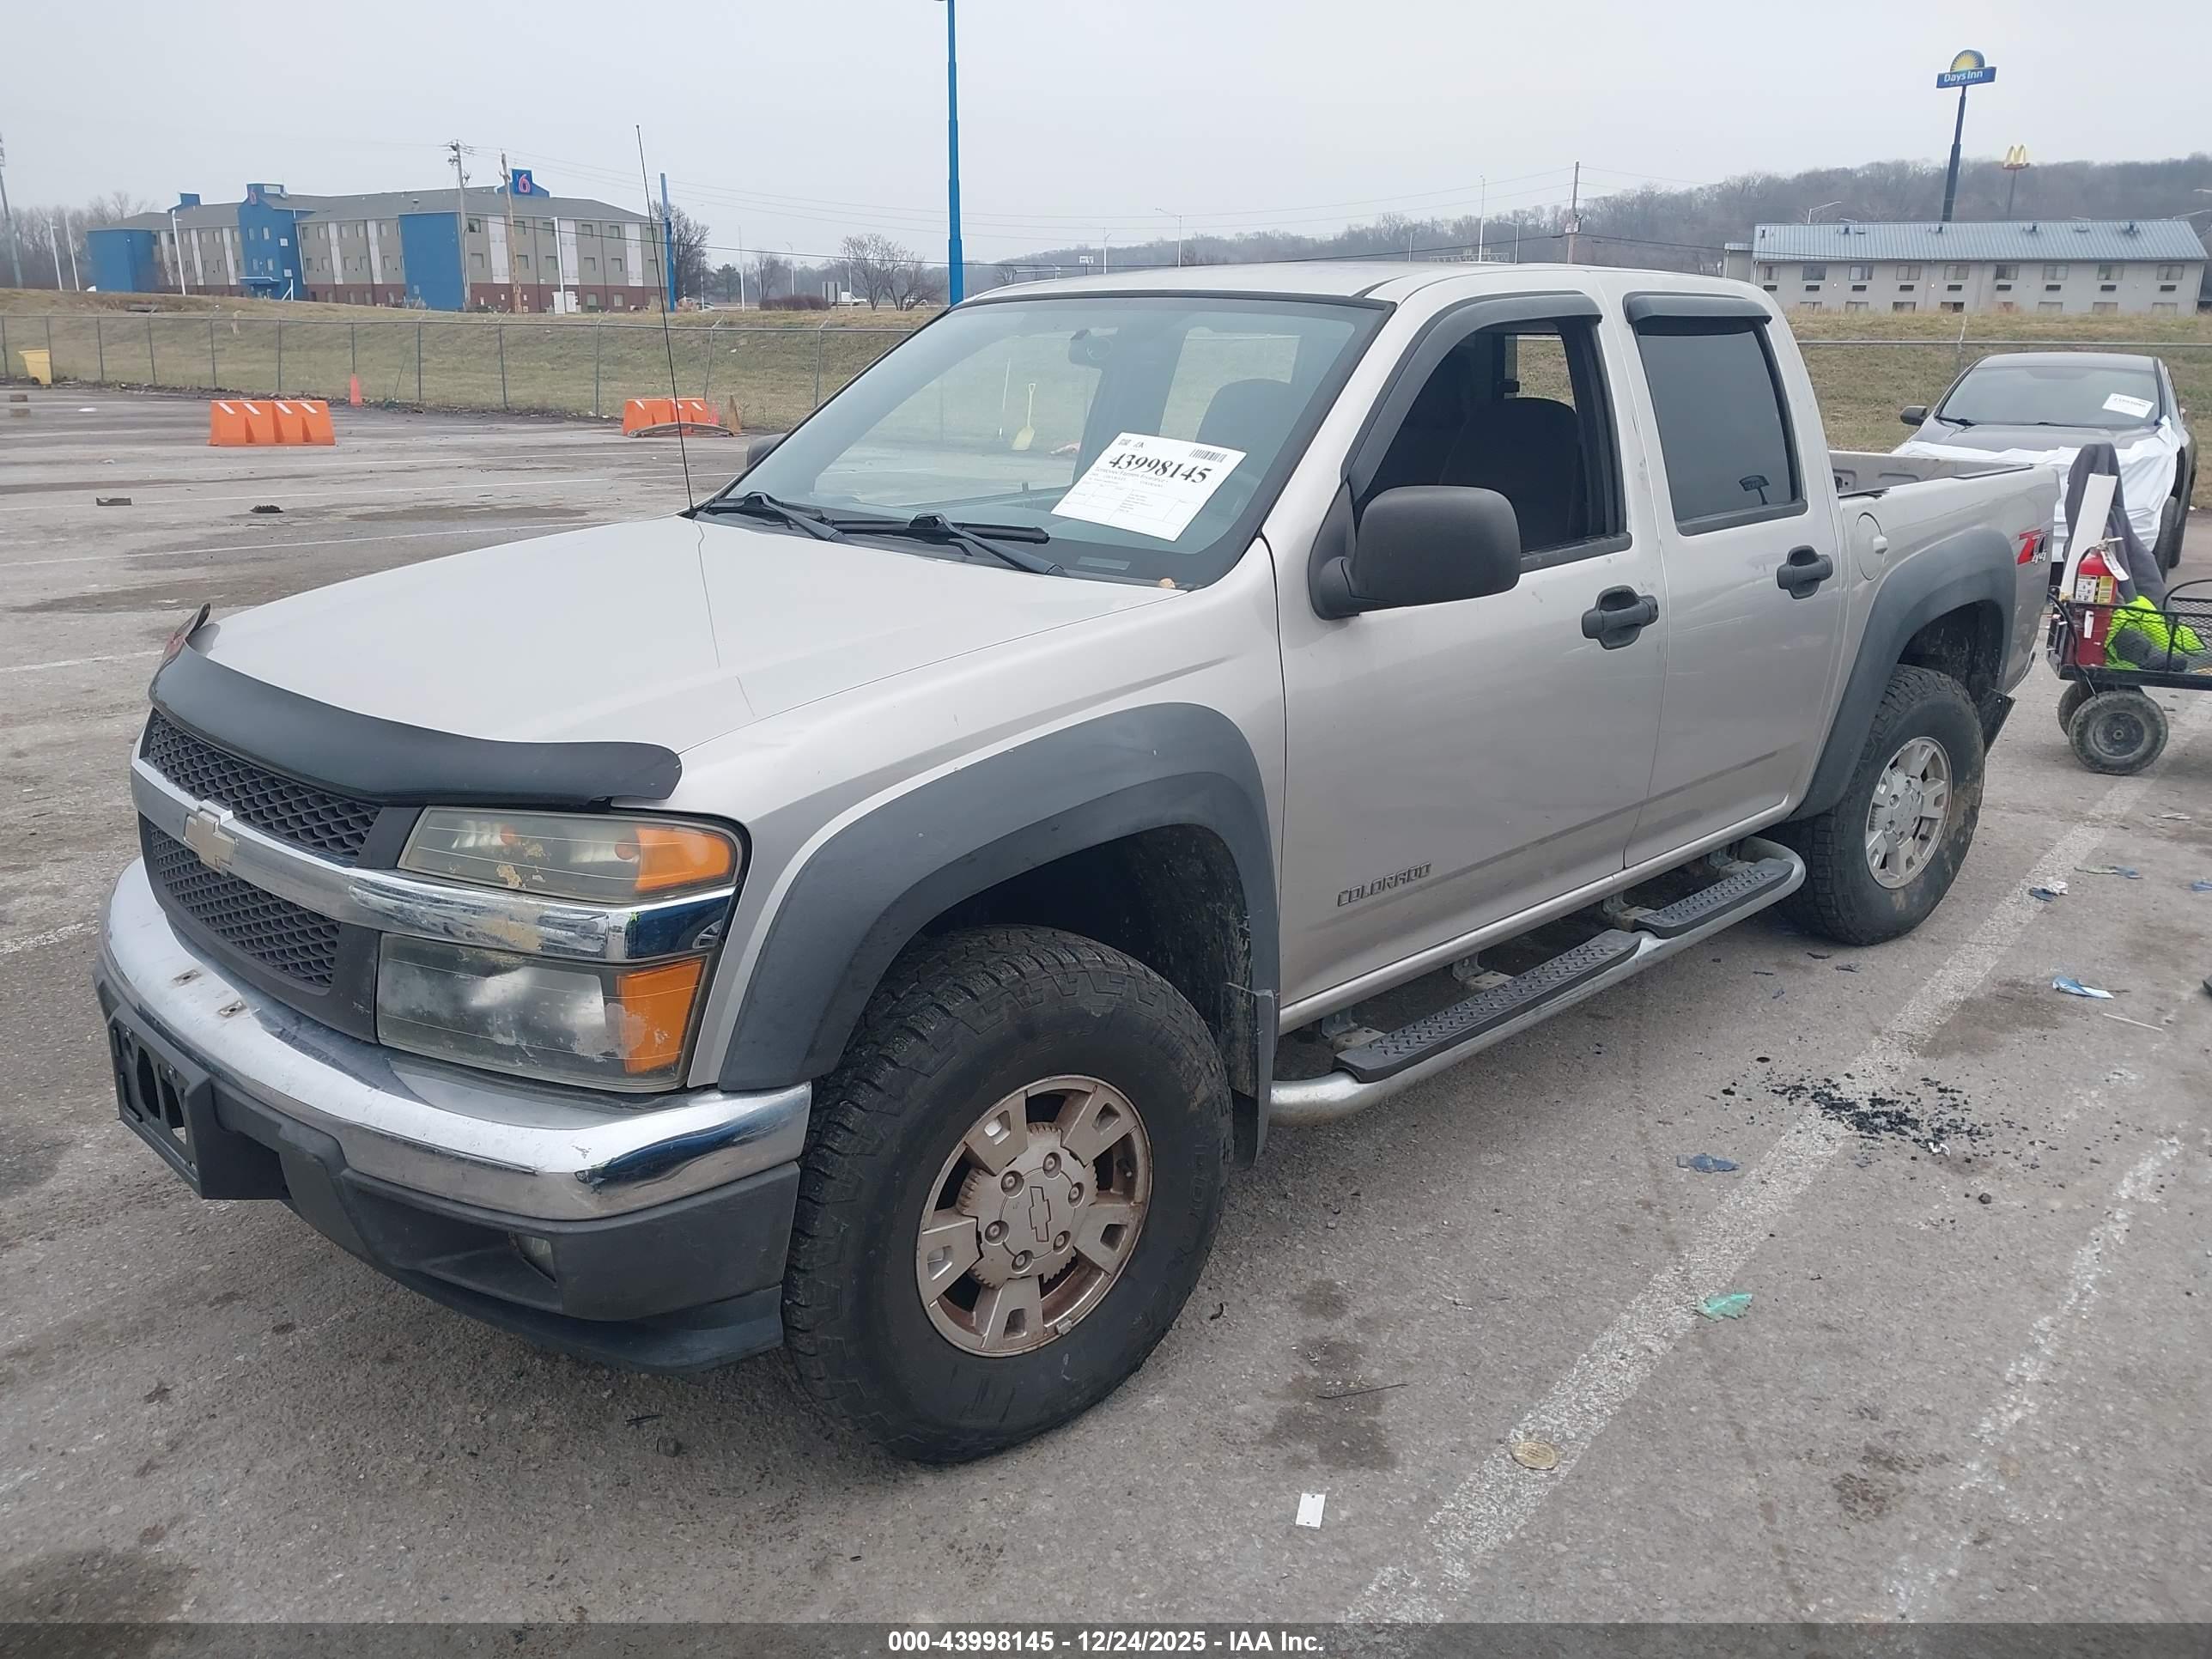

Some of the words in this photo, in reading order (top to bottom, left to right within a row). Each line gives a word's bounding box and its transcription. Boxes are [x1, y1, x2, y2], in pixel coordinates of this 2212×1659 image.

[1943, 72, 1966, 83] Days
[1966, 70, 1984, 80] Inn
[518, 173, 531, 193] 6
[1109, 453, 1212, 483] 43998145
[1337, 861, 1431, 908] COLORADO
